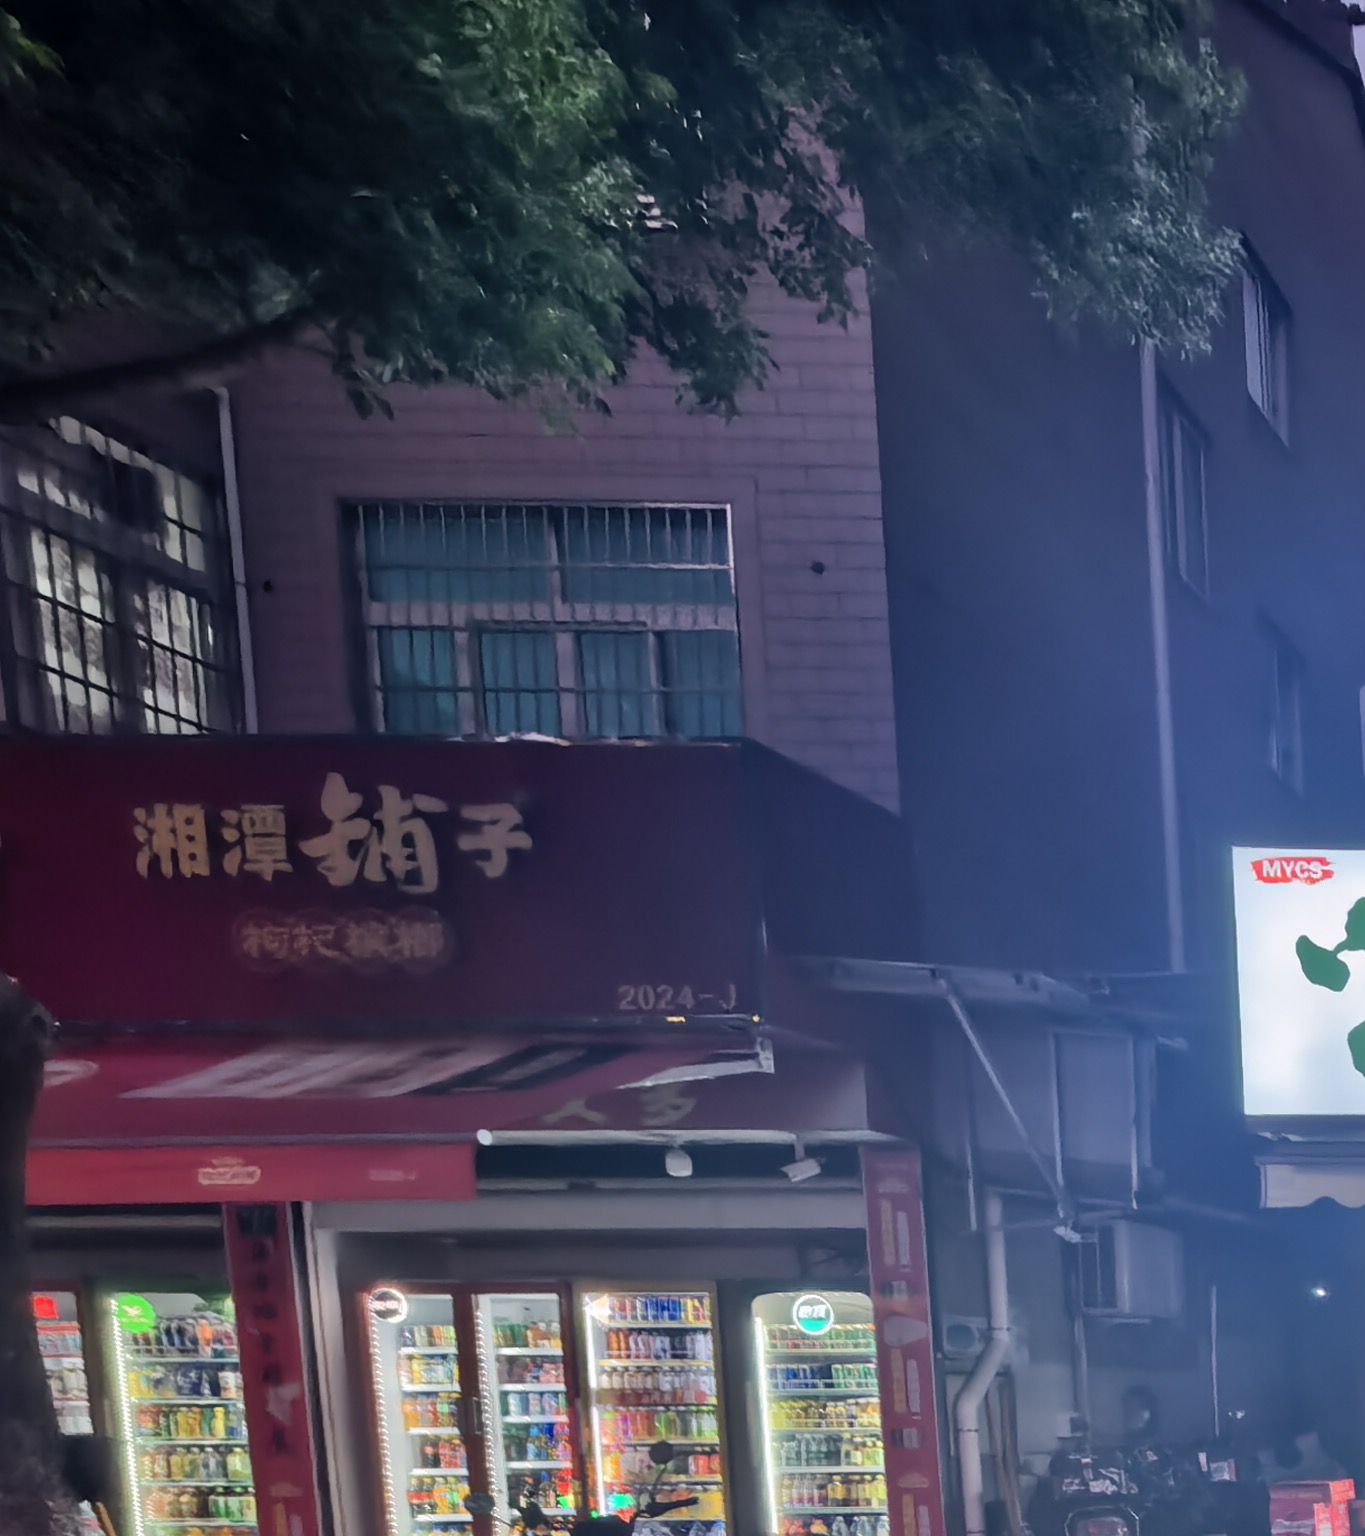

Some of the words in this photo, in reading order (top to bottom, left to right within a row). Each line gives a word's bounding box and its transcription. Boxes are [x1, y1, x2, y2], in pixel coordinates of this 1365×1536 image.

[133, 772, 533, 894] 湘潭铺子
[1262, 860, 1323, 878] MYCS
